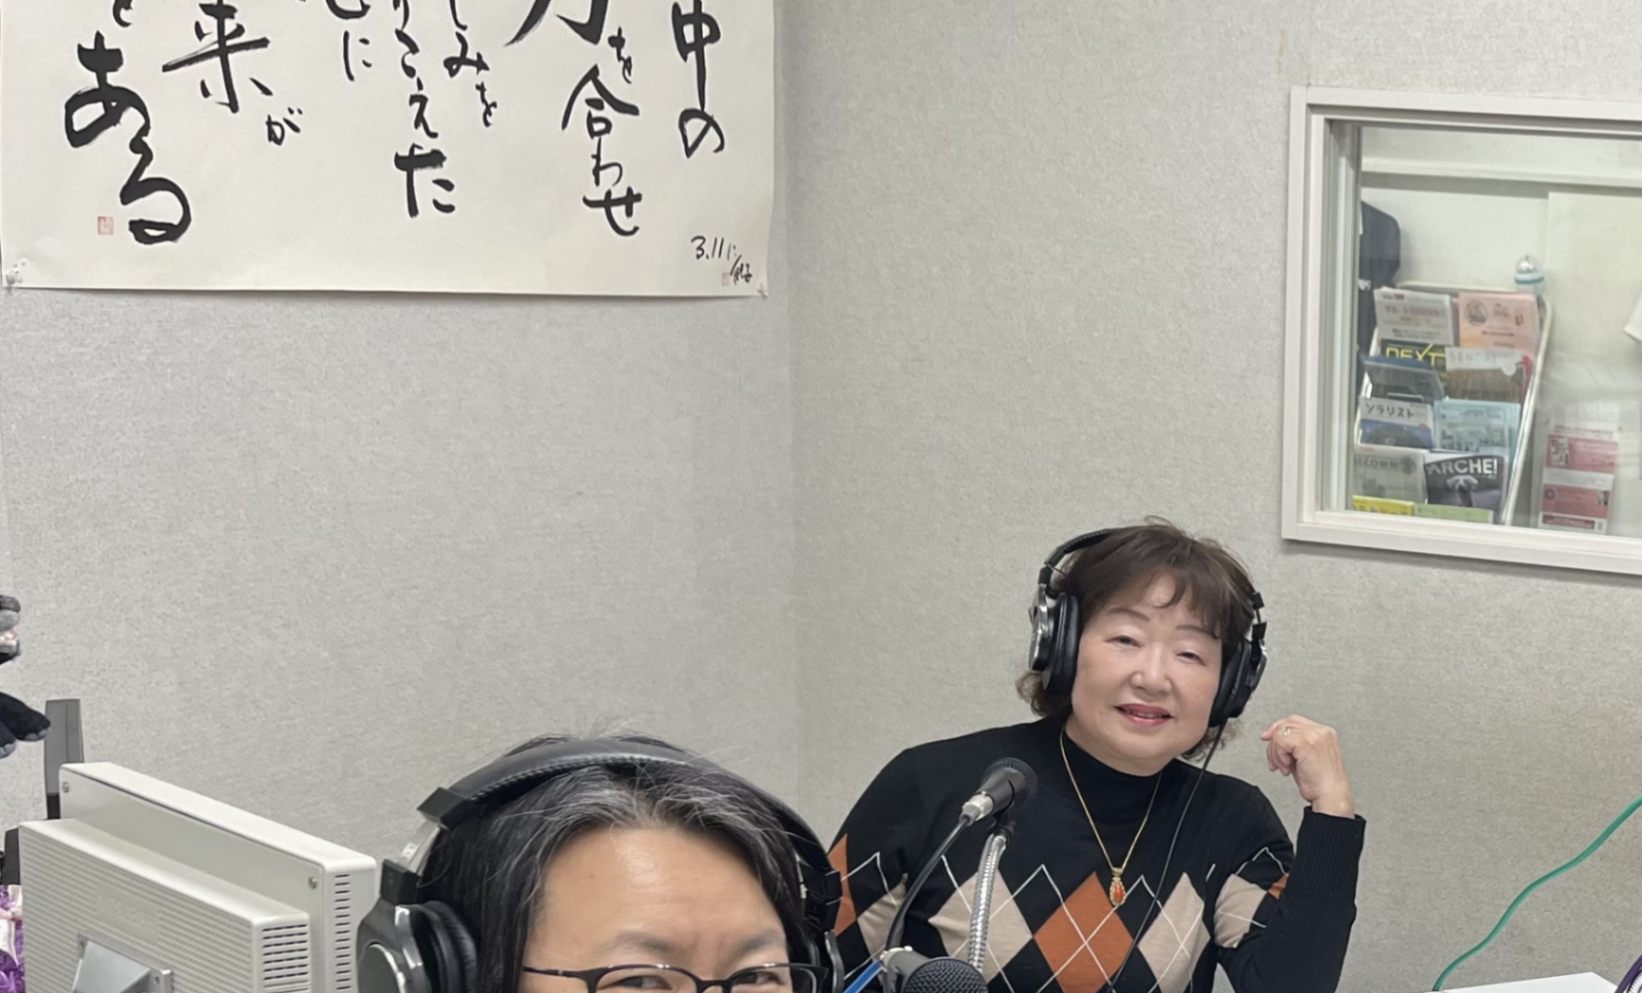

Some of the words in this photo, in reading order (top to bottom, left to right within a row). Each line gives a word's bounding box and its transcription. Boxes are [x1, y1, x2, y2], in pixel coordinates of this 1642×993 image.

[1366, 403, 1415, 418] ソラリスト
